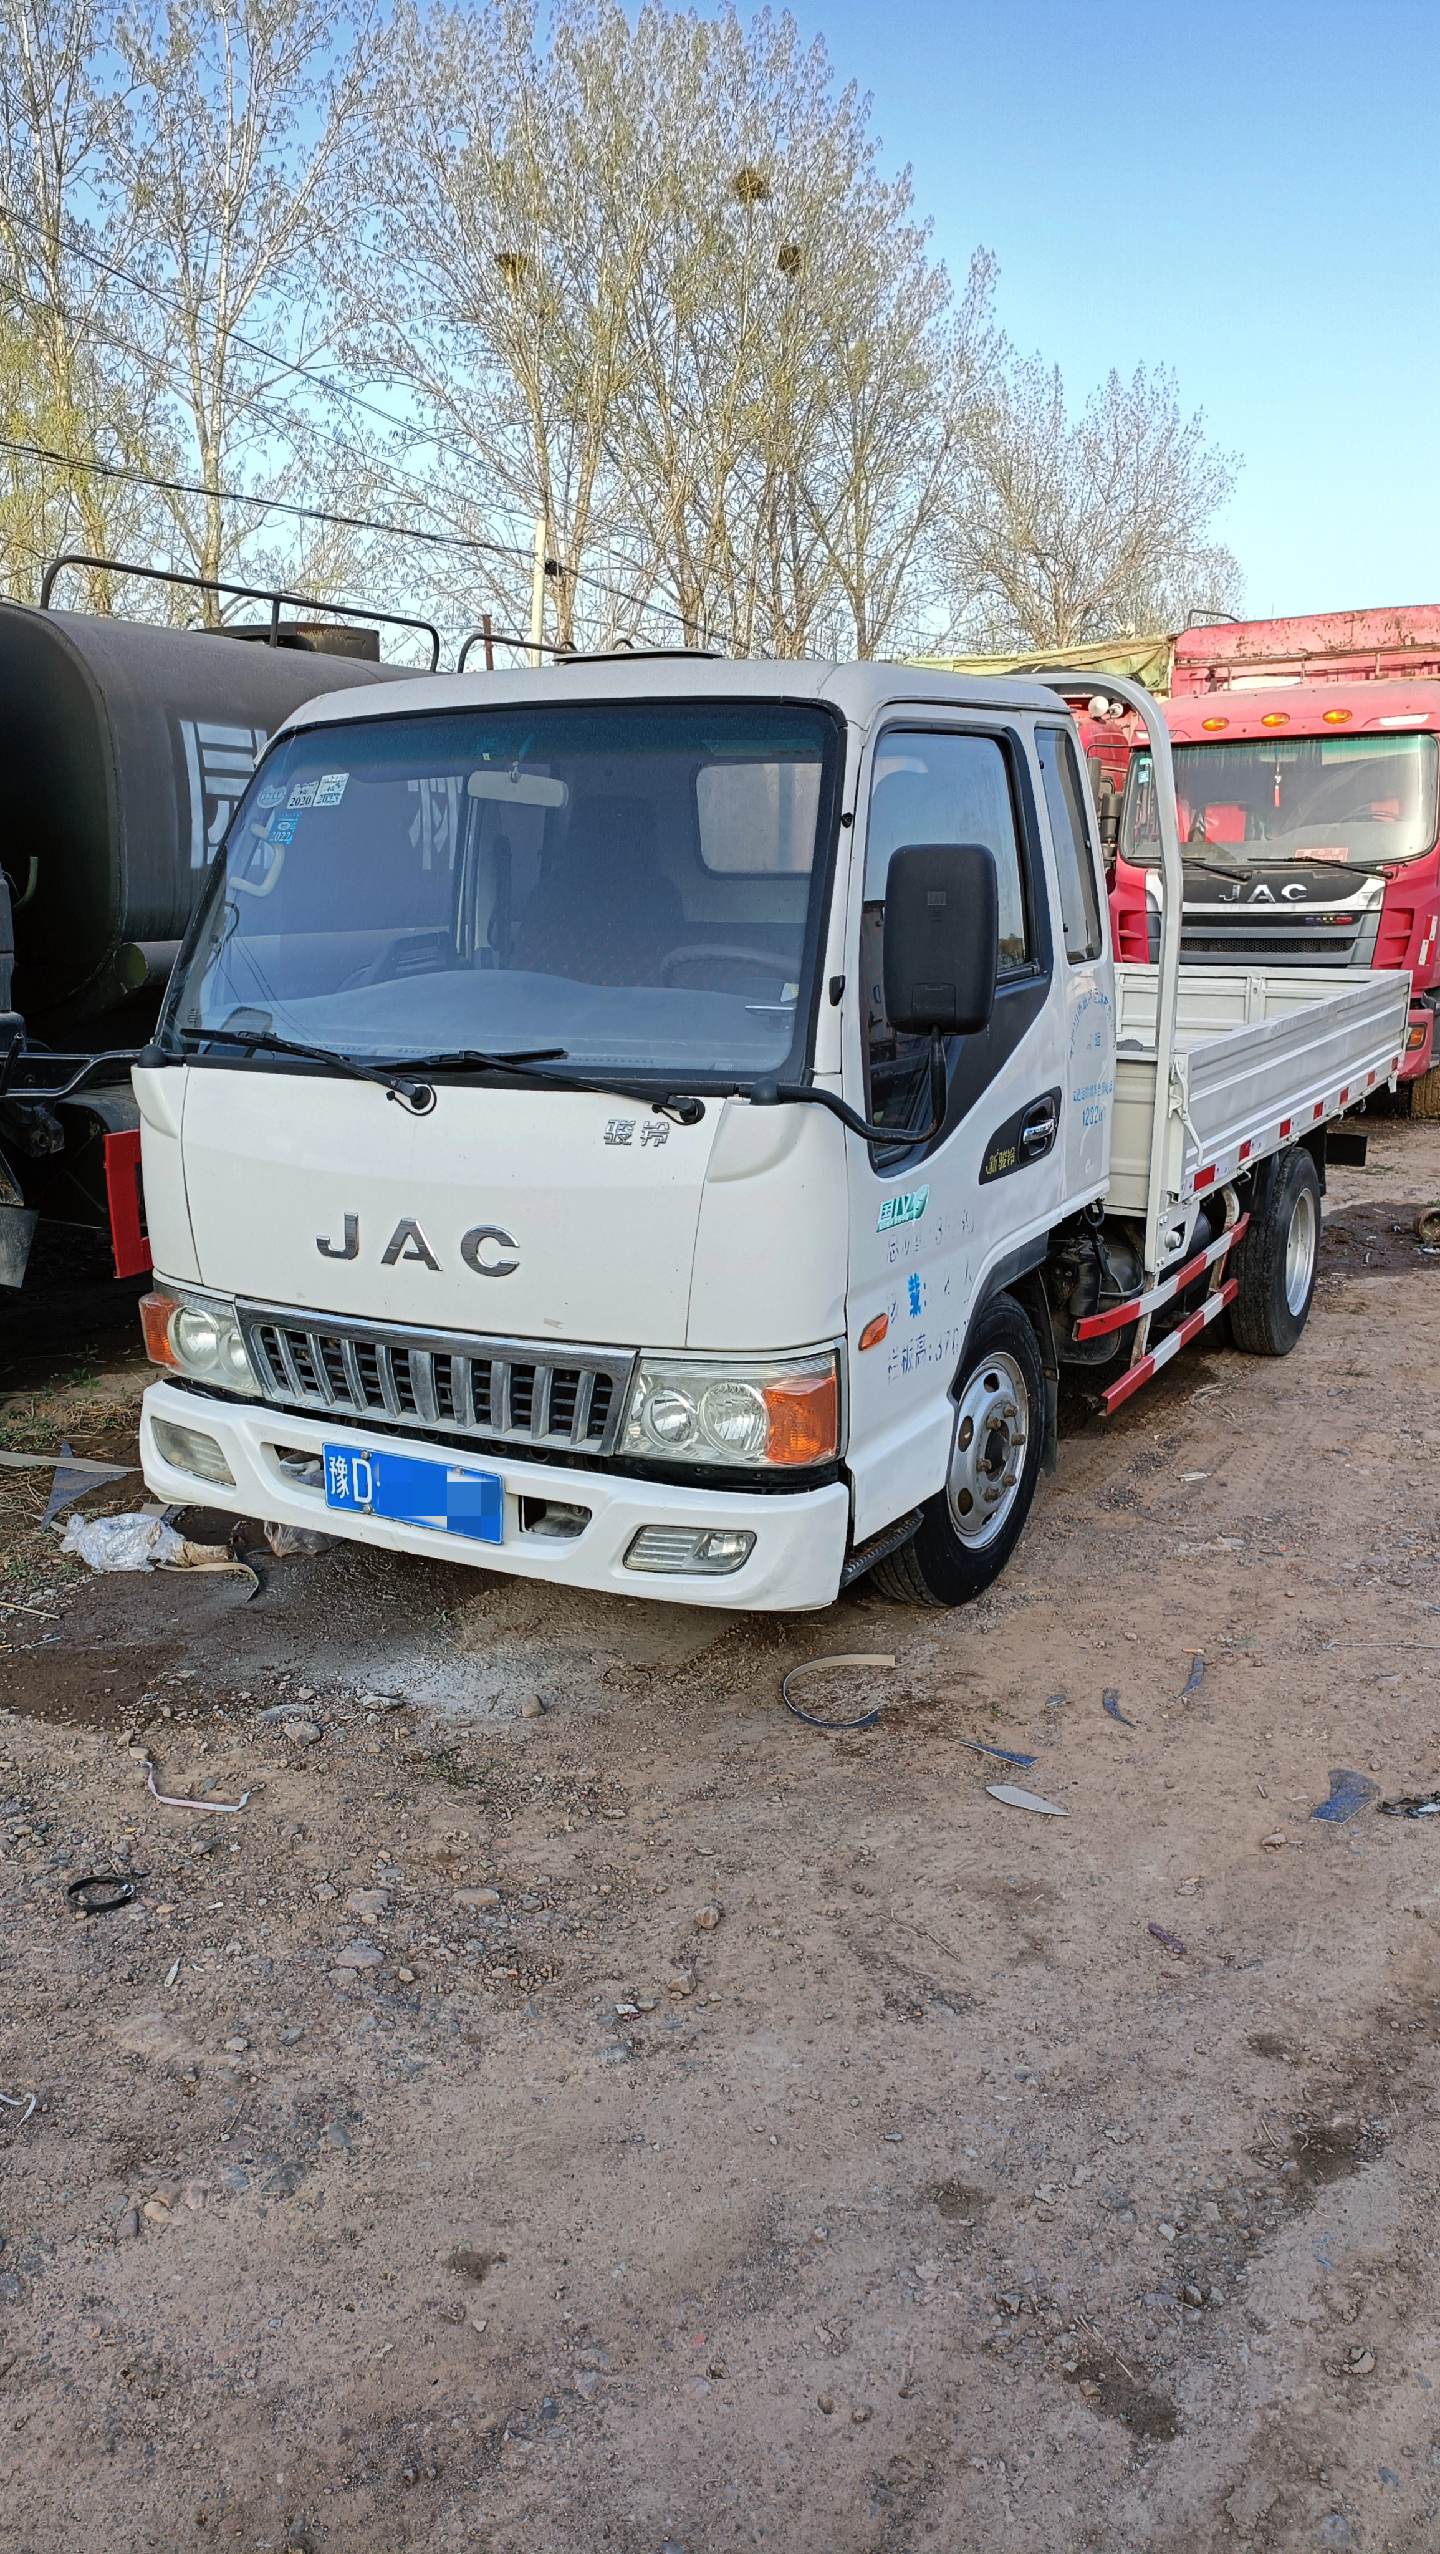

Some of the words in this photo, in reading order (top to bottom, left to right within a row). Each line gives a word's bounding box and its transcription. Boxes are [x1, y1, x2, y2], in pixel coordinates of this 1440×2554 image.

[289, 795, 312, 807] 2020
[1218, 883, 1309, 904] JAC
[316, 1211, 520, 1278] JAC
